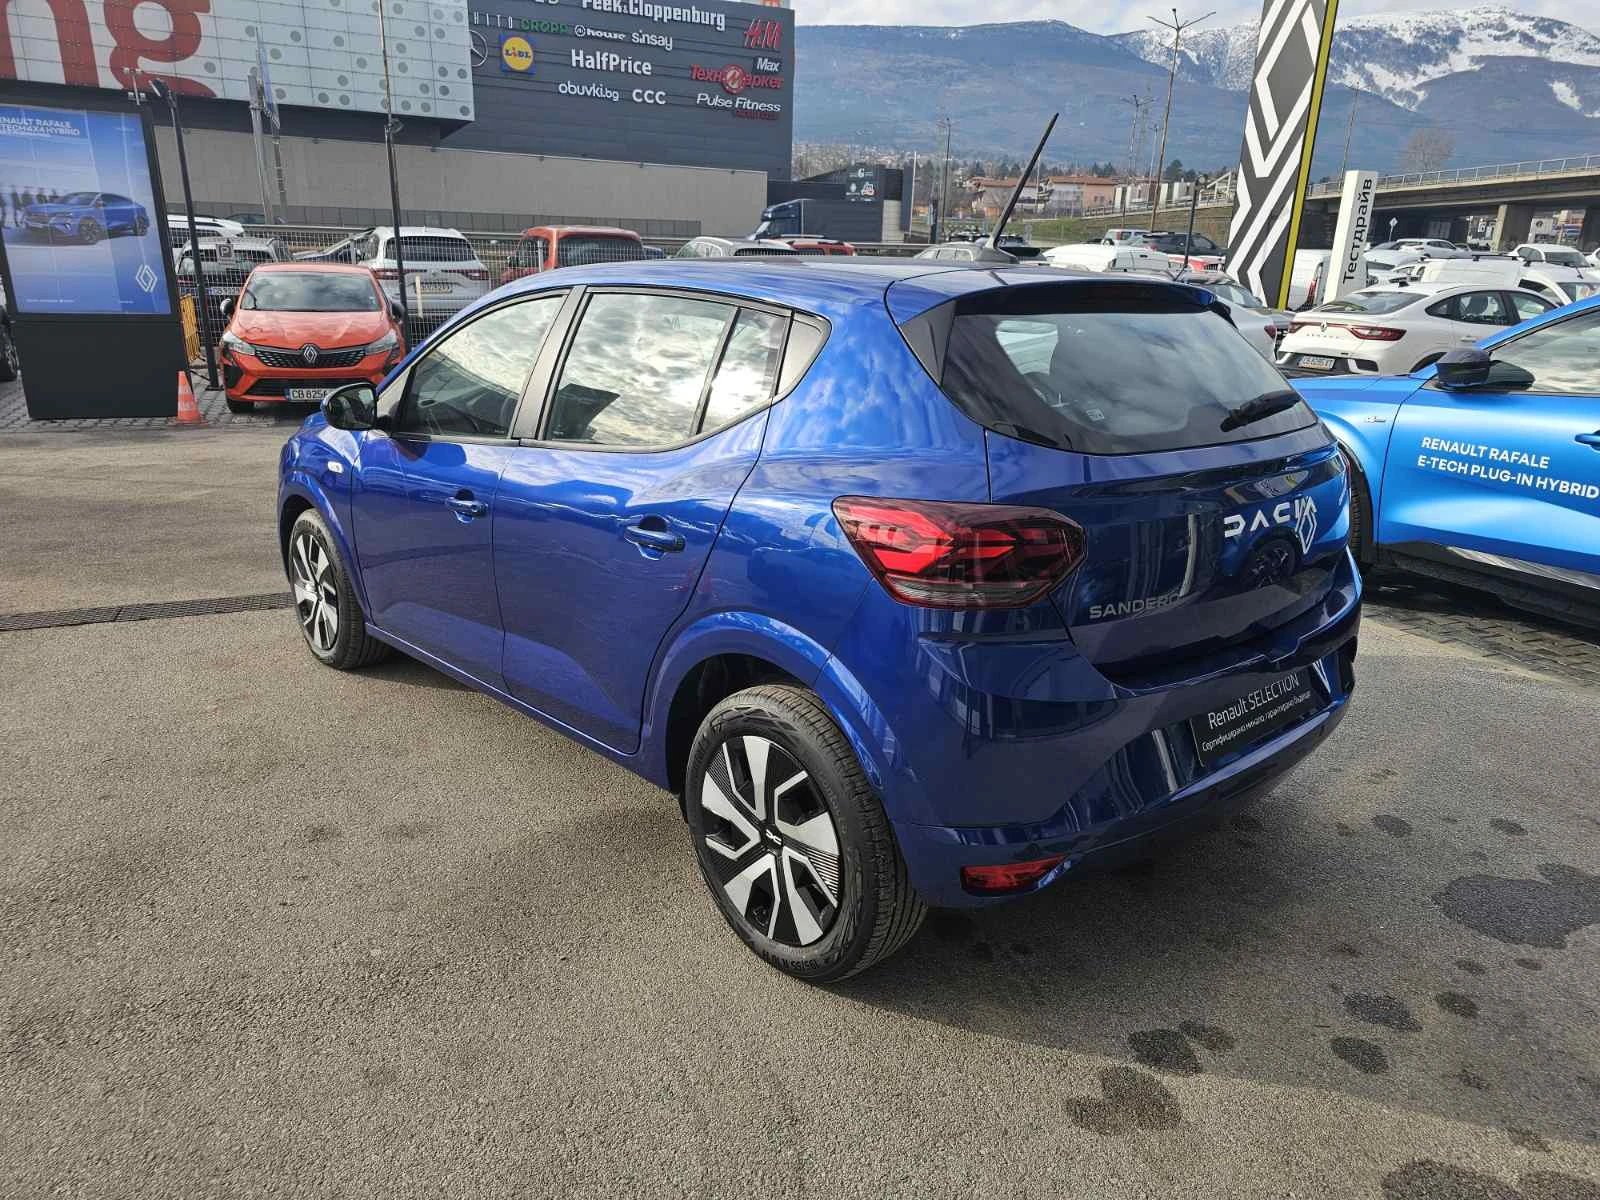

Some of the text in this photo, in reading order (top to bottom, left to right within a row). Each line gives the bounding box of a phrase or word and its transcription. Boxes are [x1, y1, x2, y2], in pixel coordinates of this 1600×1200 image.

[631, 30, 673, 50] sinsay
[571, 48, 652, 75] HalfPrice
[756, 57, 780, 72] Max
[558, 81, 620, 102] obuvki.bg
[632, 89, 667, 105] CCC
[696, 92, 781, 112] Pulse Fitness
[1342, 178, 1373, 285] Тестдрайв
[1421, 436, 1550, 469] RENAULT RAFALE
[1417, 455, 1600, 499] E-TECH PLUG-IN HYBRID
[1089, 592, 1183, 619] SANDERO
[1207, 672, 1300, 729] Renault SELECTION
